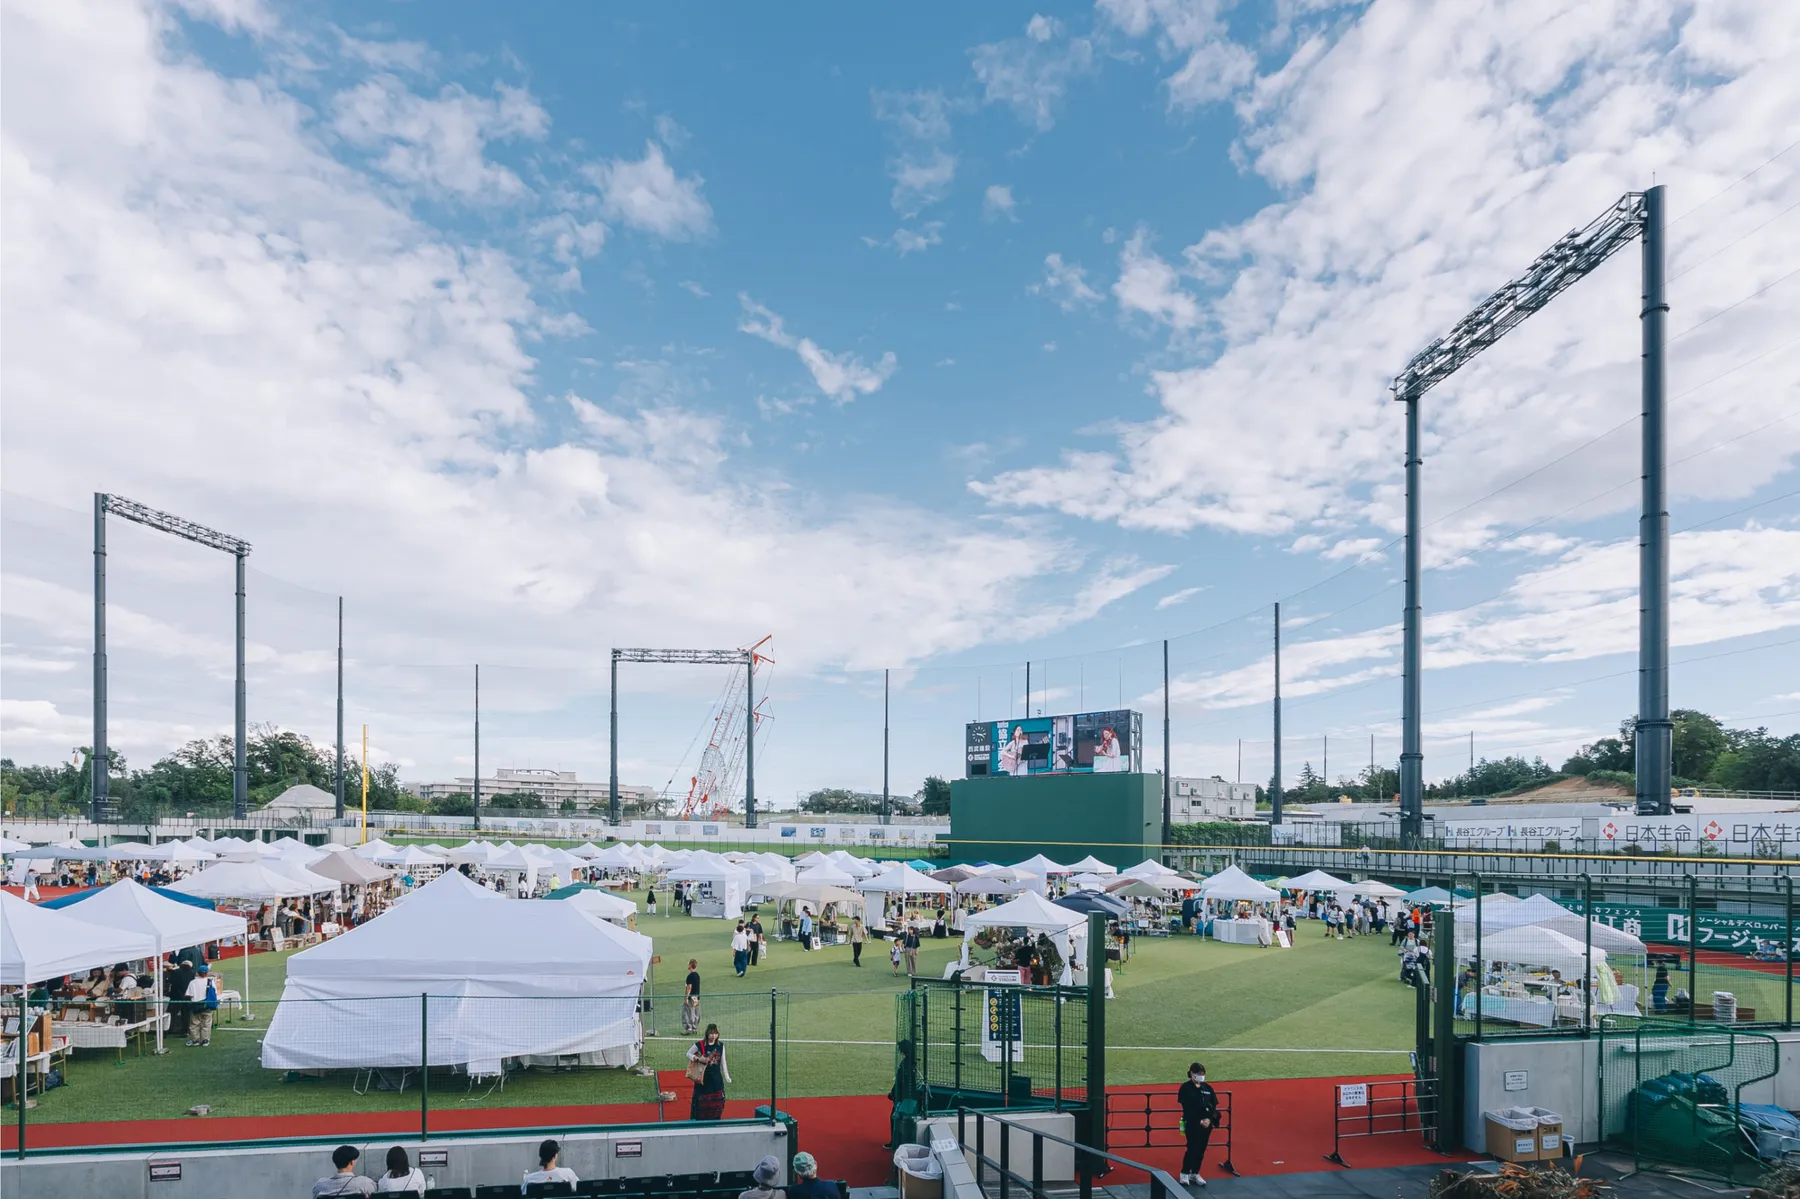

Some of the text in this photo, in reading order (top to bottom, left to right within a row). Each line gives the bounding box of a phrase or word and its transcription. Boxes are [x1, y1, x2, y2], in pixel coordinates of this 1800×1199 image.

[1456, 826, 1505, 837] 長谷工グループ
[1520, 825, 1581, 837] 長谷工グループ
[1625, 824, 1692, 842] 日本生命
[1699, 917, 1787, 930] ソーシャルデベロッパー
